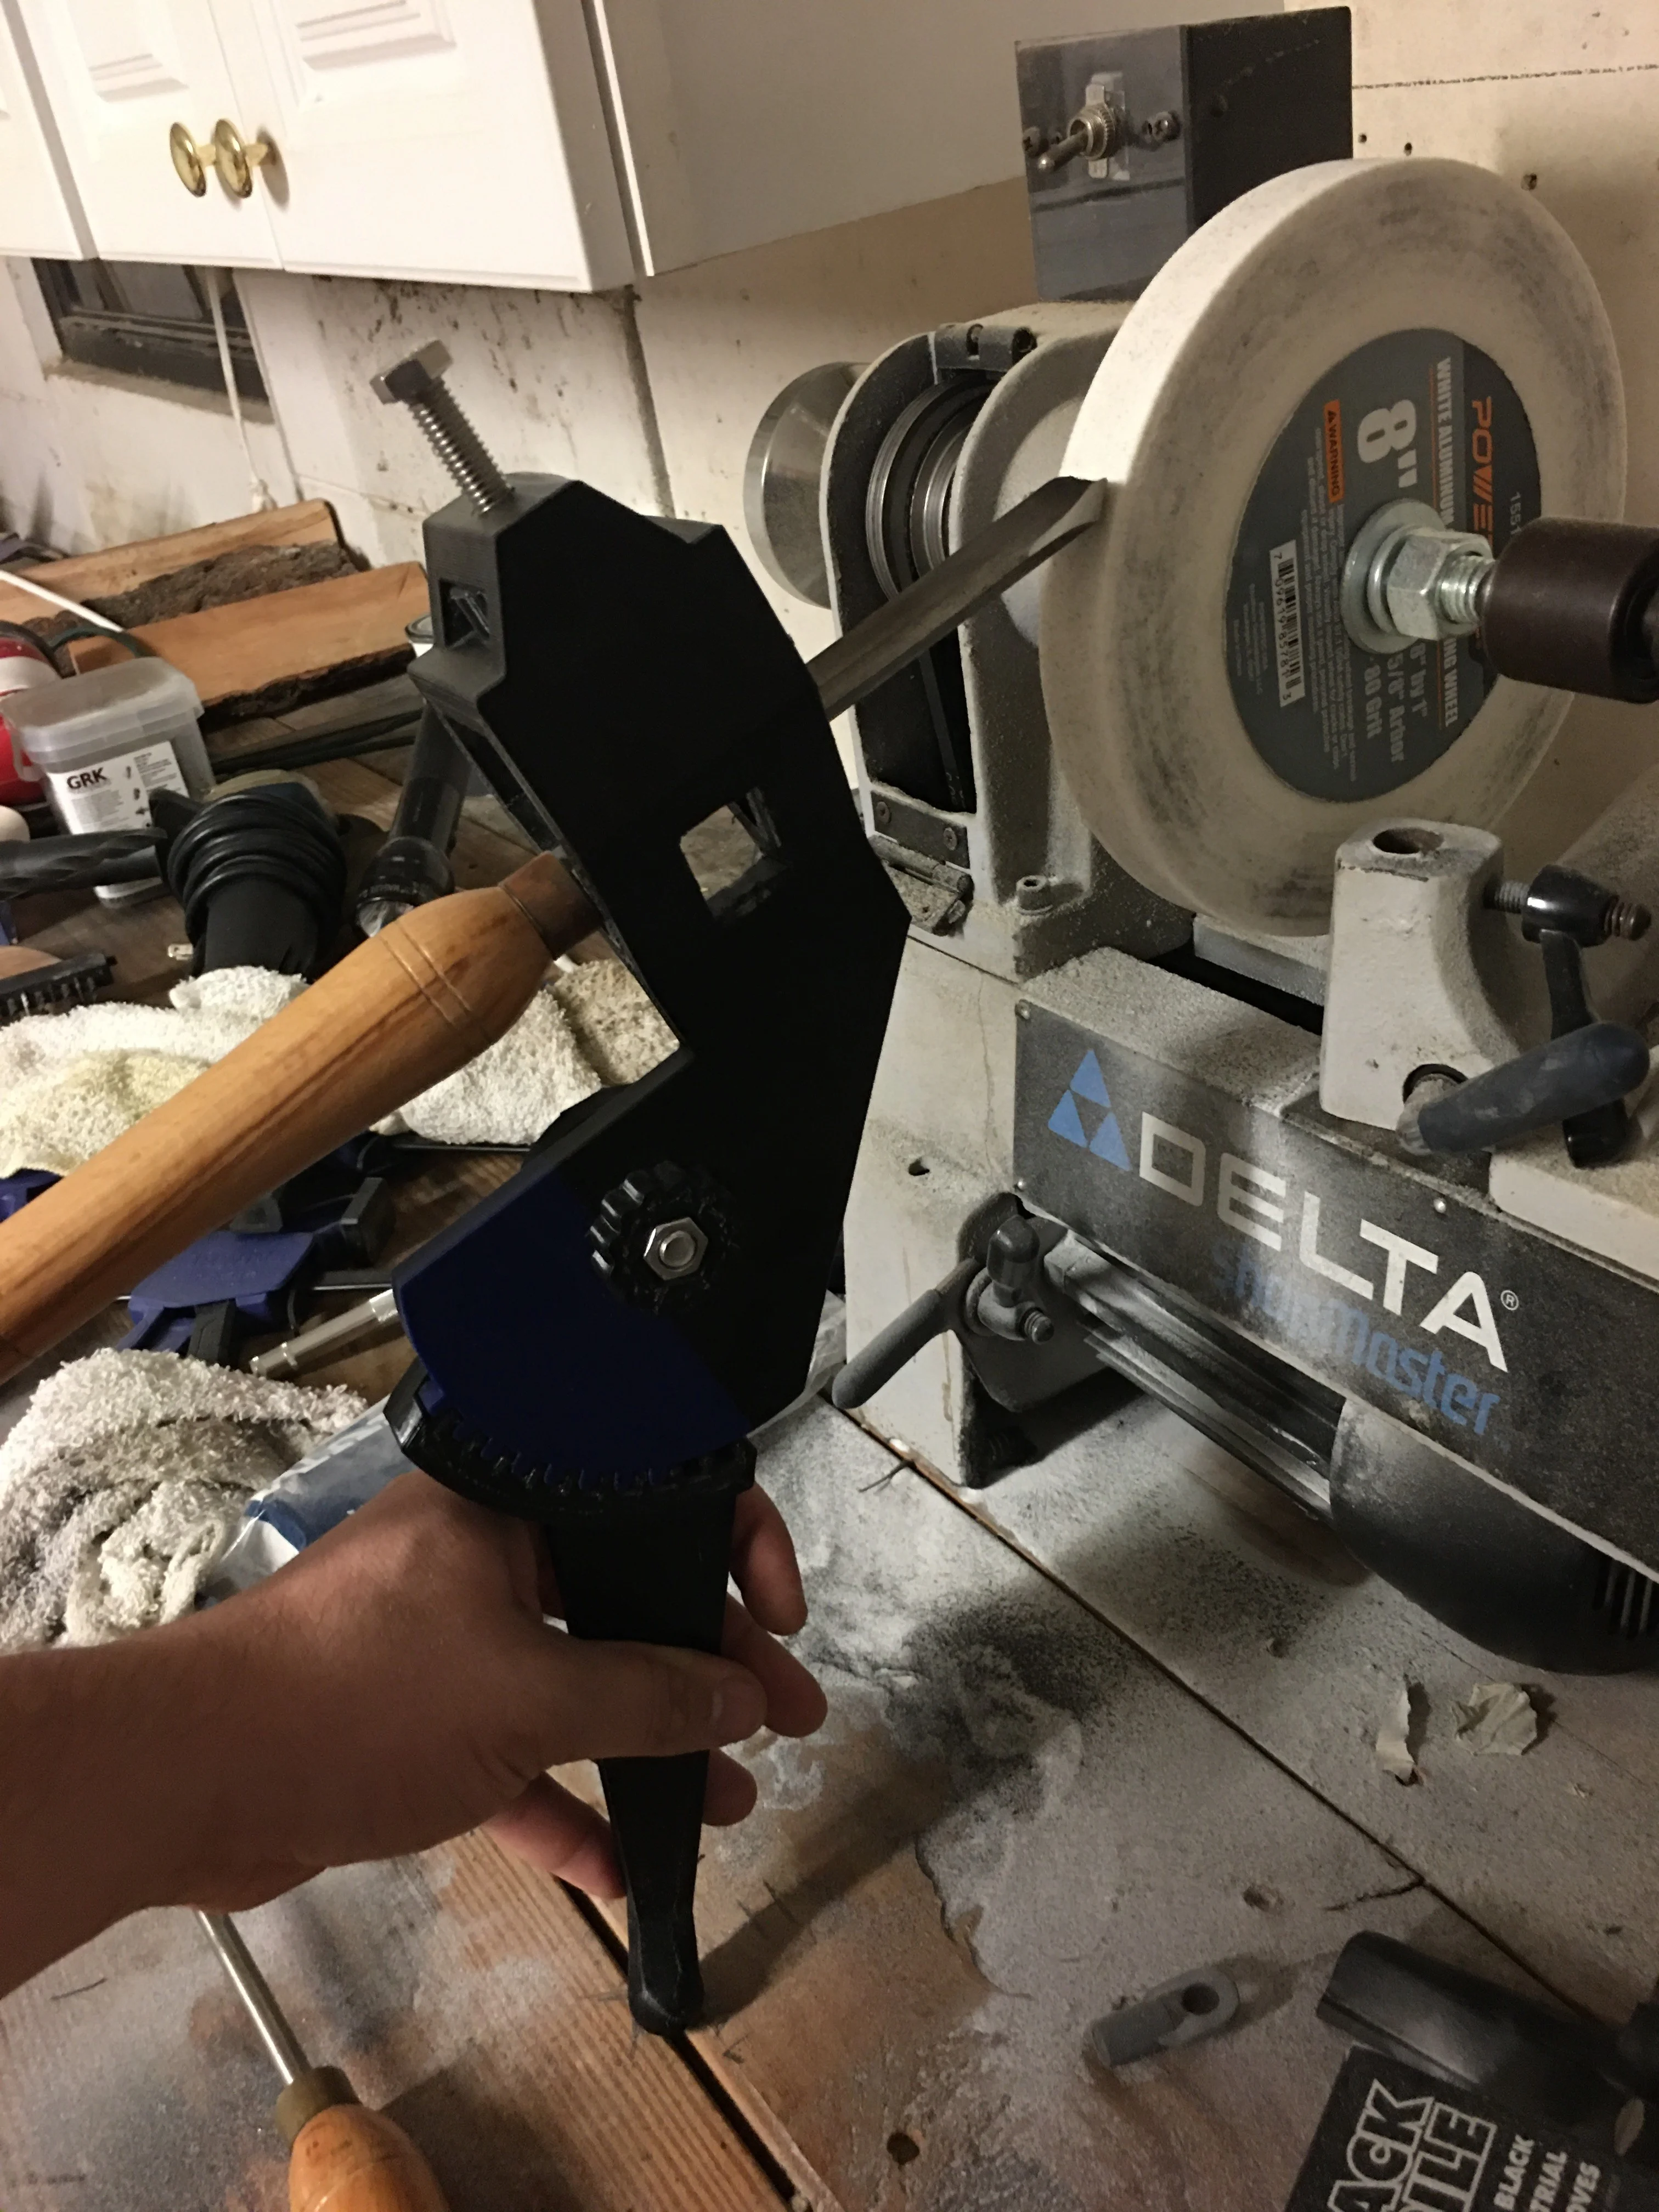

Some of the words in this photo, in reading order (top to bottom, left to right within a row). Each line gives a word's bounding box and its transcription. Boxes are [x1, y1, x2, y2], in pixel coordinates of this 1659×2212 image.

[1437, 357, 1452, 423] WHITE
[1328, 424, 1341, 496] WARNING
[1438, 425, 1454, 525] ALUMINUM
[1472, 395, 1493, 540] POWE
[1409, 669, 1427, 698] by
[1444, 669, 1458, 727] WHEEL
[1365, 696, 1383, 740] Grit
[1389, 705, 1406, 762] Arbor
[66, 767, 108, 789] GRK
[1139, 1111, 1508, 1373] DELTA
[1493, 2133, 1536, 2211] BLACK
